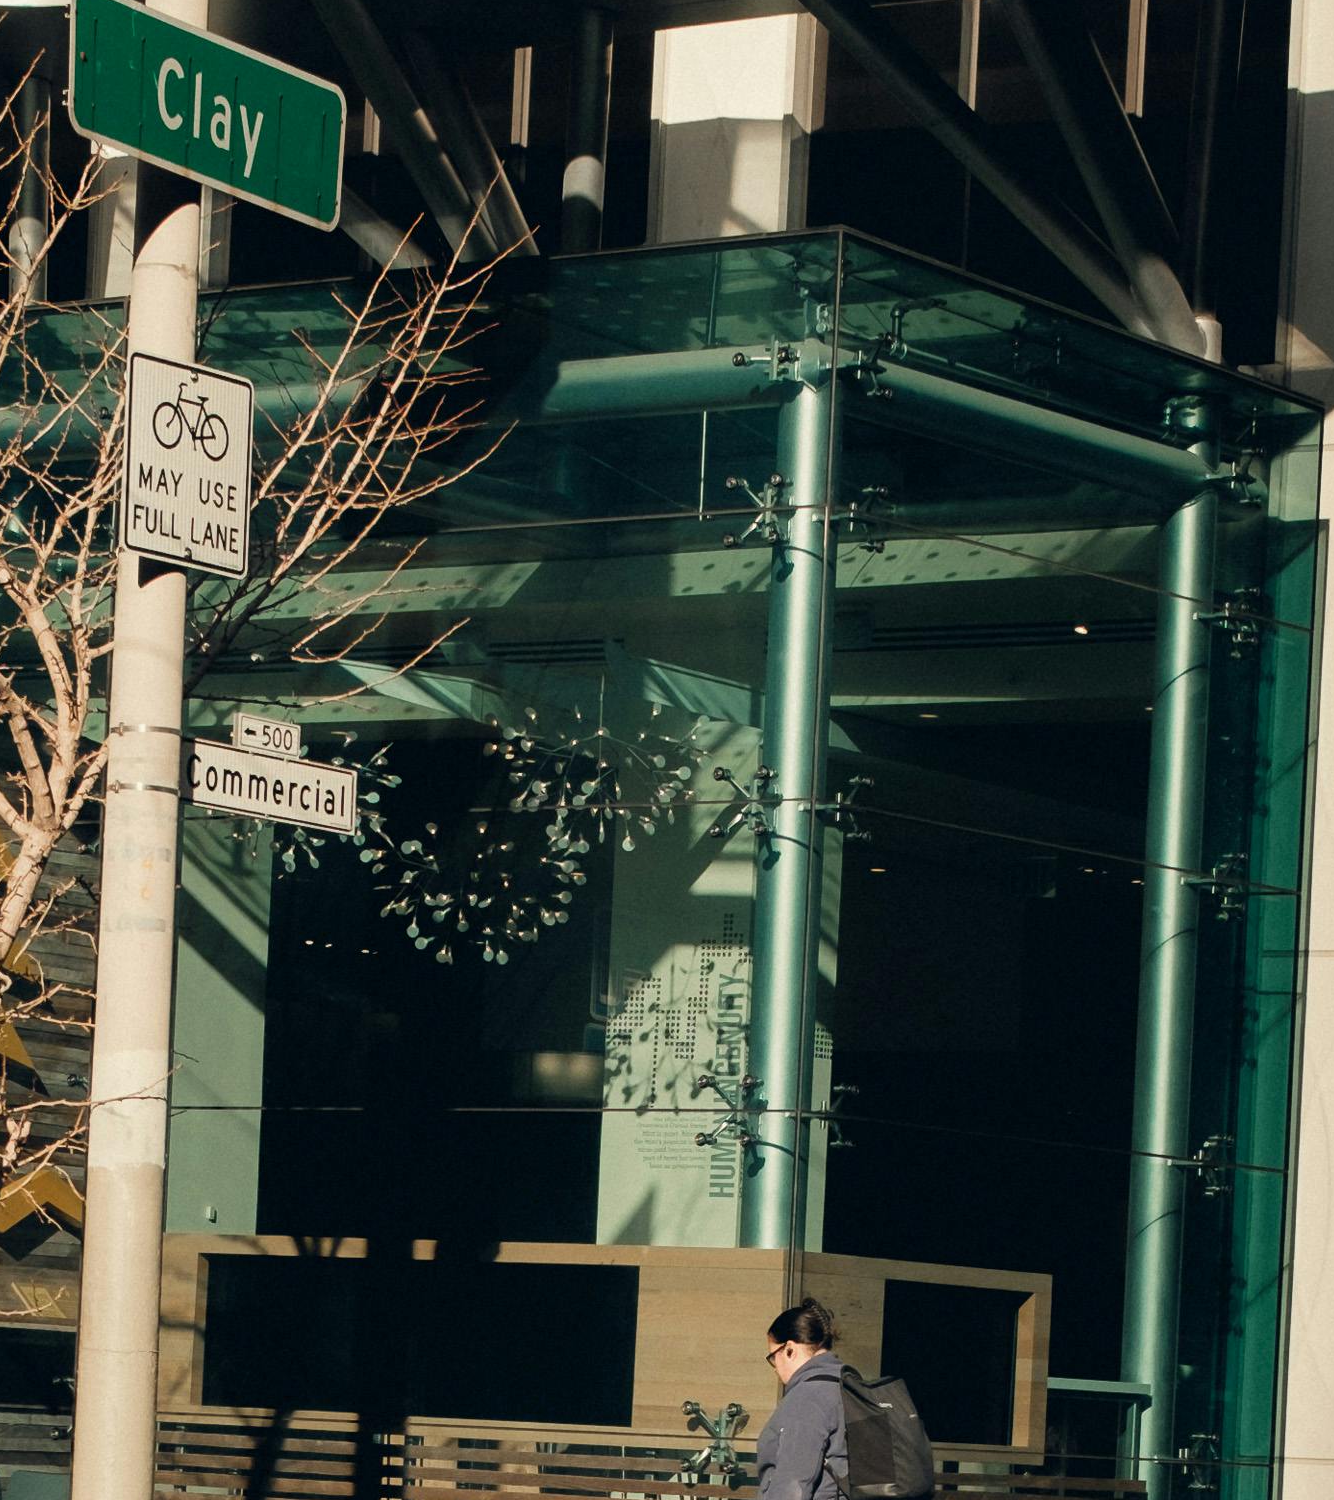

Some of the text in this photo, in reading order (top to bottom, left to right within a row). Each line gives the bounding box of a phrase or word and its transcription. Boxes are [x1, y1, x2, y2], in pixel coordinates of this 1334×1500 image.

[157, 57, 264, 179] Clay
[138, 462, 237, 513] MAY USE
[133, 503, 239, 555] FULL LANE
[261, 724, 293, 751] 500
[186, 753, 345, 817] Commercial
